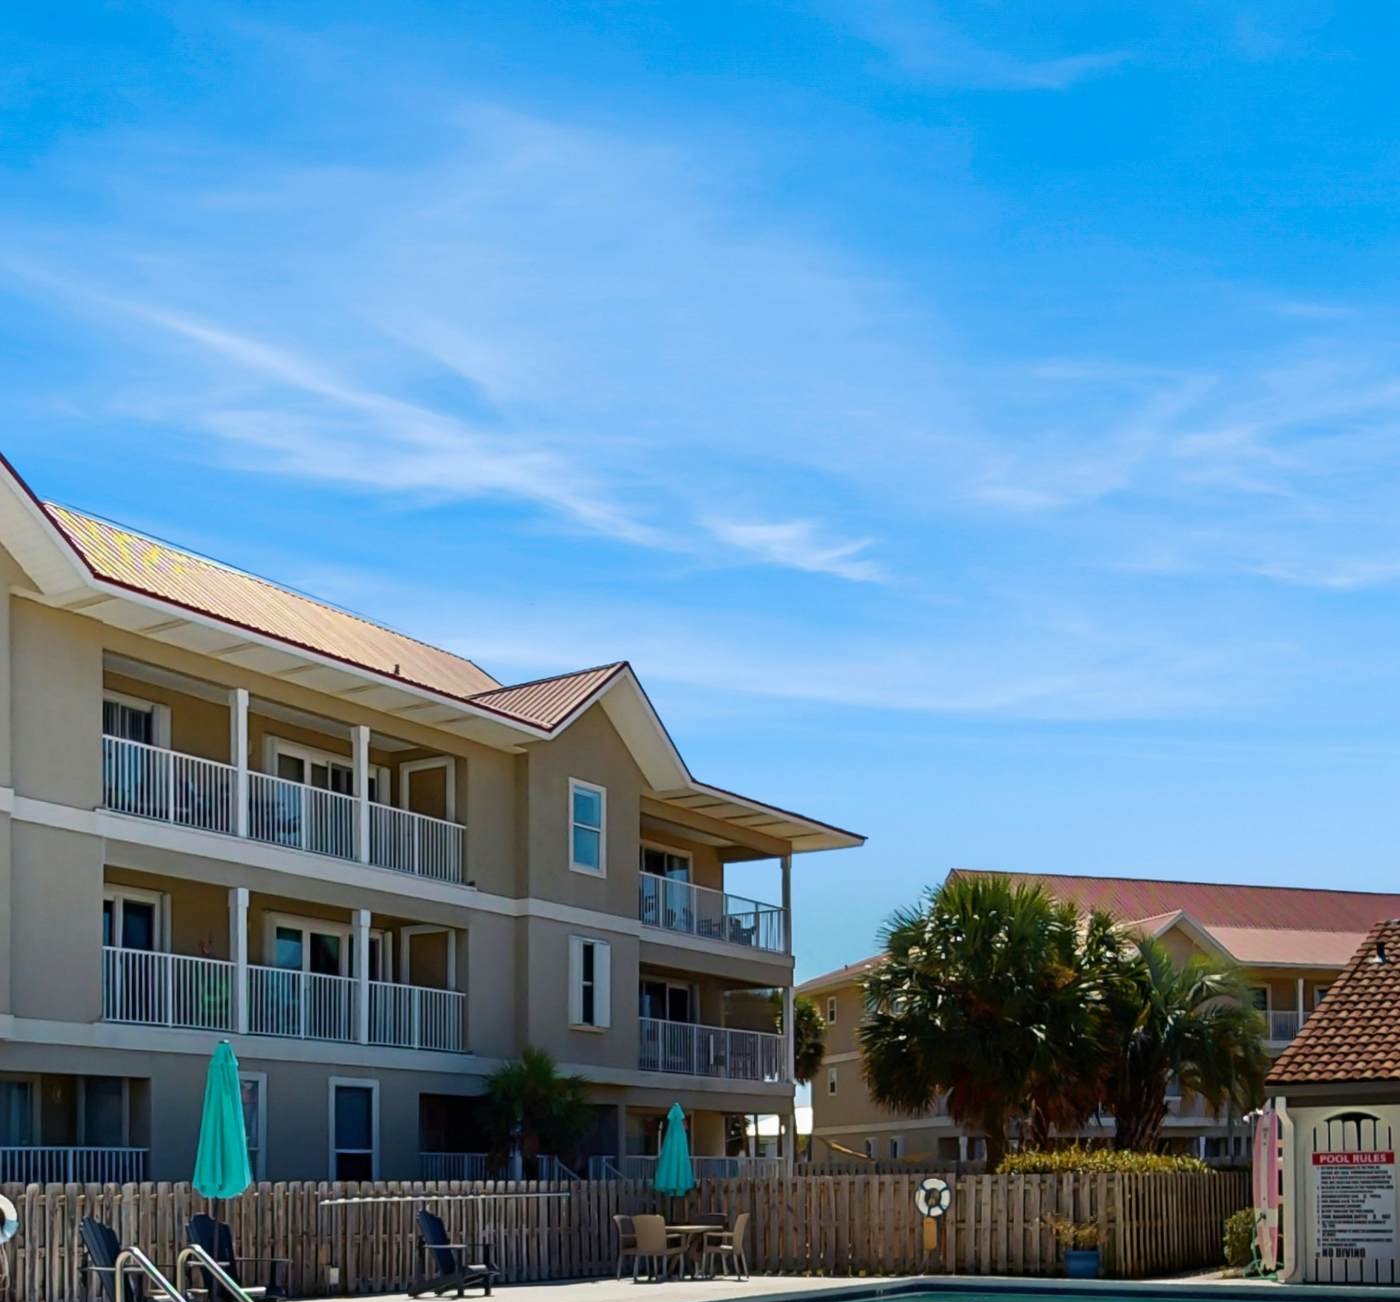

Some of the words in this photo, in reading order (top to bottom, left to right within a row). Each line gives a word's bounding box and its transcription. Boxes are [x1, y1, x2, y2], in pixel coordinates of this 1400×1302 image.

[1319, 1155, 1350, 1164] POOL
[1352, 1153, 1387, 1163] RULES
[1322, 1247, 1334, 1258] NO
[1335, 1247, 1366, 1258] DIVING
